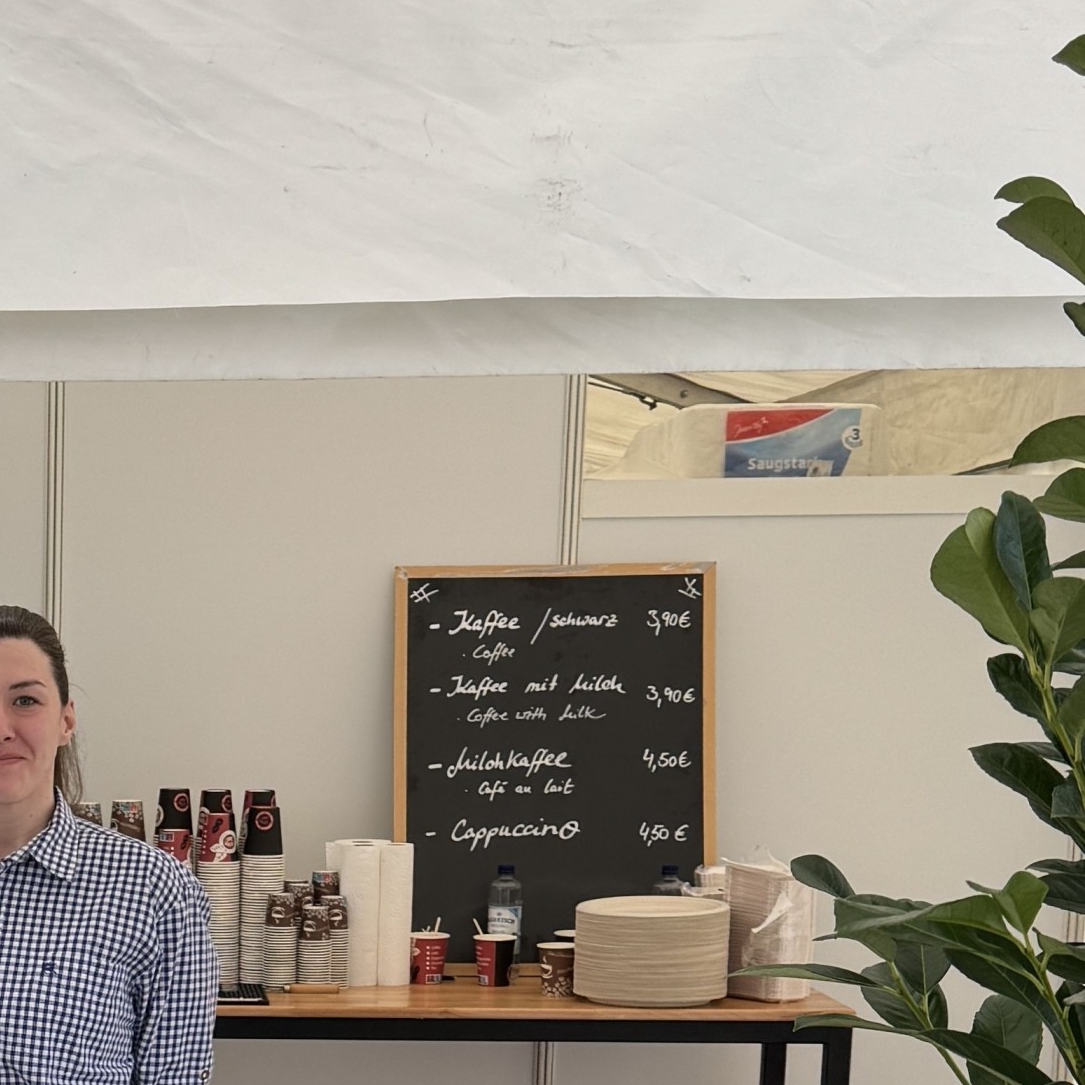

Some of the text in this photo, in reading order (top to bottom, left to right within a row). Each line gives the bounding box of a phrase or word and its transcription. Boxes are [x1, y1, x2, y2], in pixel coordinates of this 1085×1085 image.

[851, 428, 860, 440] 3
[448, 610, 521, 638] Kaffee
[472, 642, 515, 665] Coffee
[447, 675, 508, 700] Kaffee
[524, 674, 558, 694] mit
[467, 707, 509, 728] Coffee
[515, 706, 547, 720] with
[515, 783, 531, 794] au
[544, 778, 575, 795] lait
